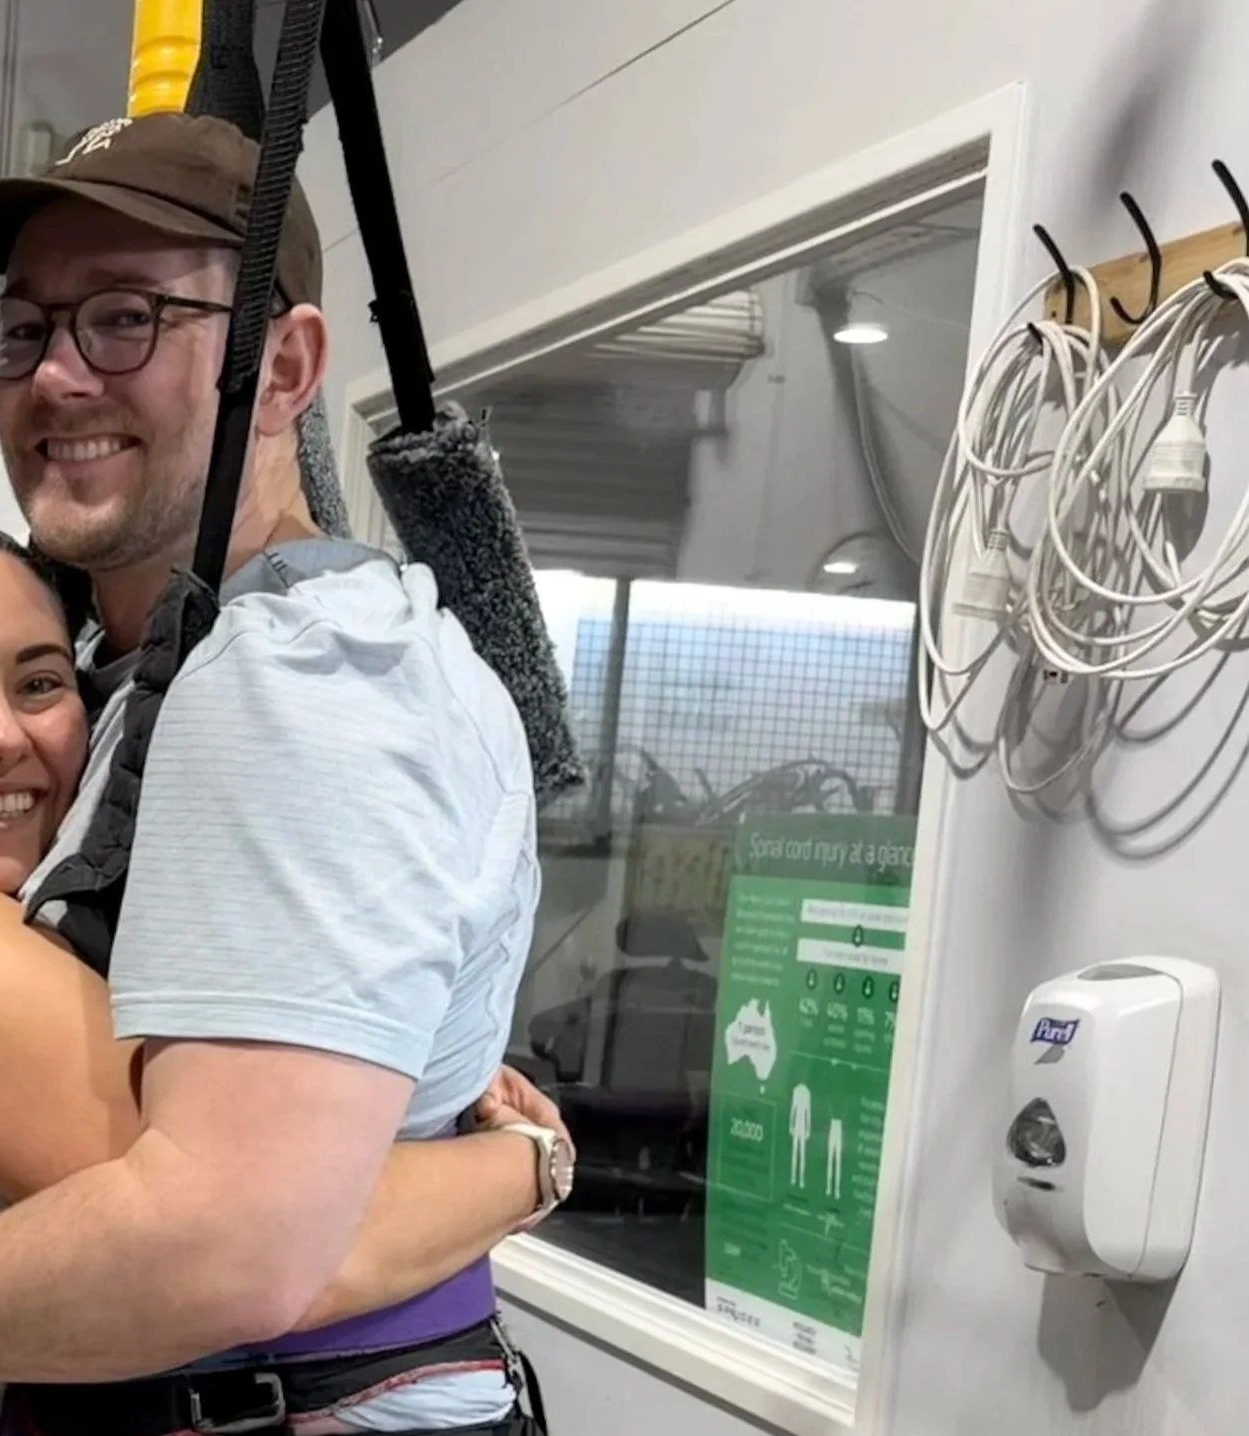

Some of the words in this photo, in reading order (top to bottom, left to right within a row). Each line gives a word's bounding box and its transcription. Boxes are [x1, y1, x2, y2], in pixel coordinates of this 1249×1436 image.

[785, 836, 813, 861] cord
[849, 837, 862, 864] at
[865, 843, 875, 865] a
[877, 839, 913, 873] glanc
